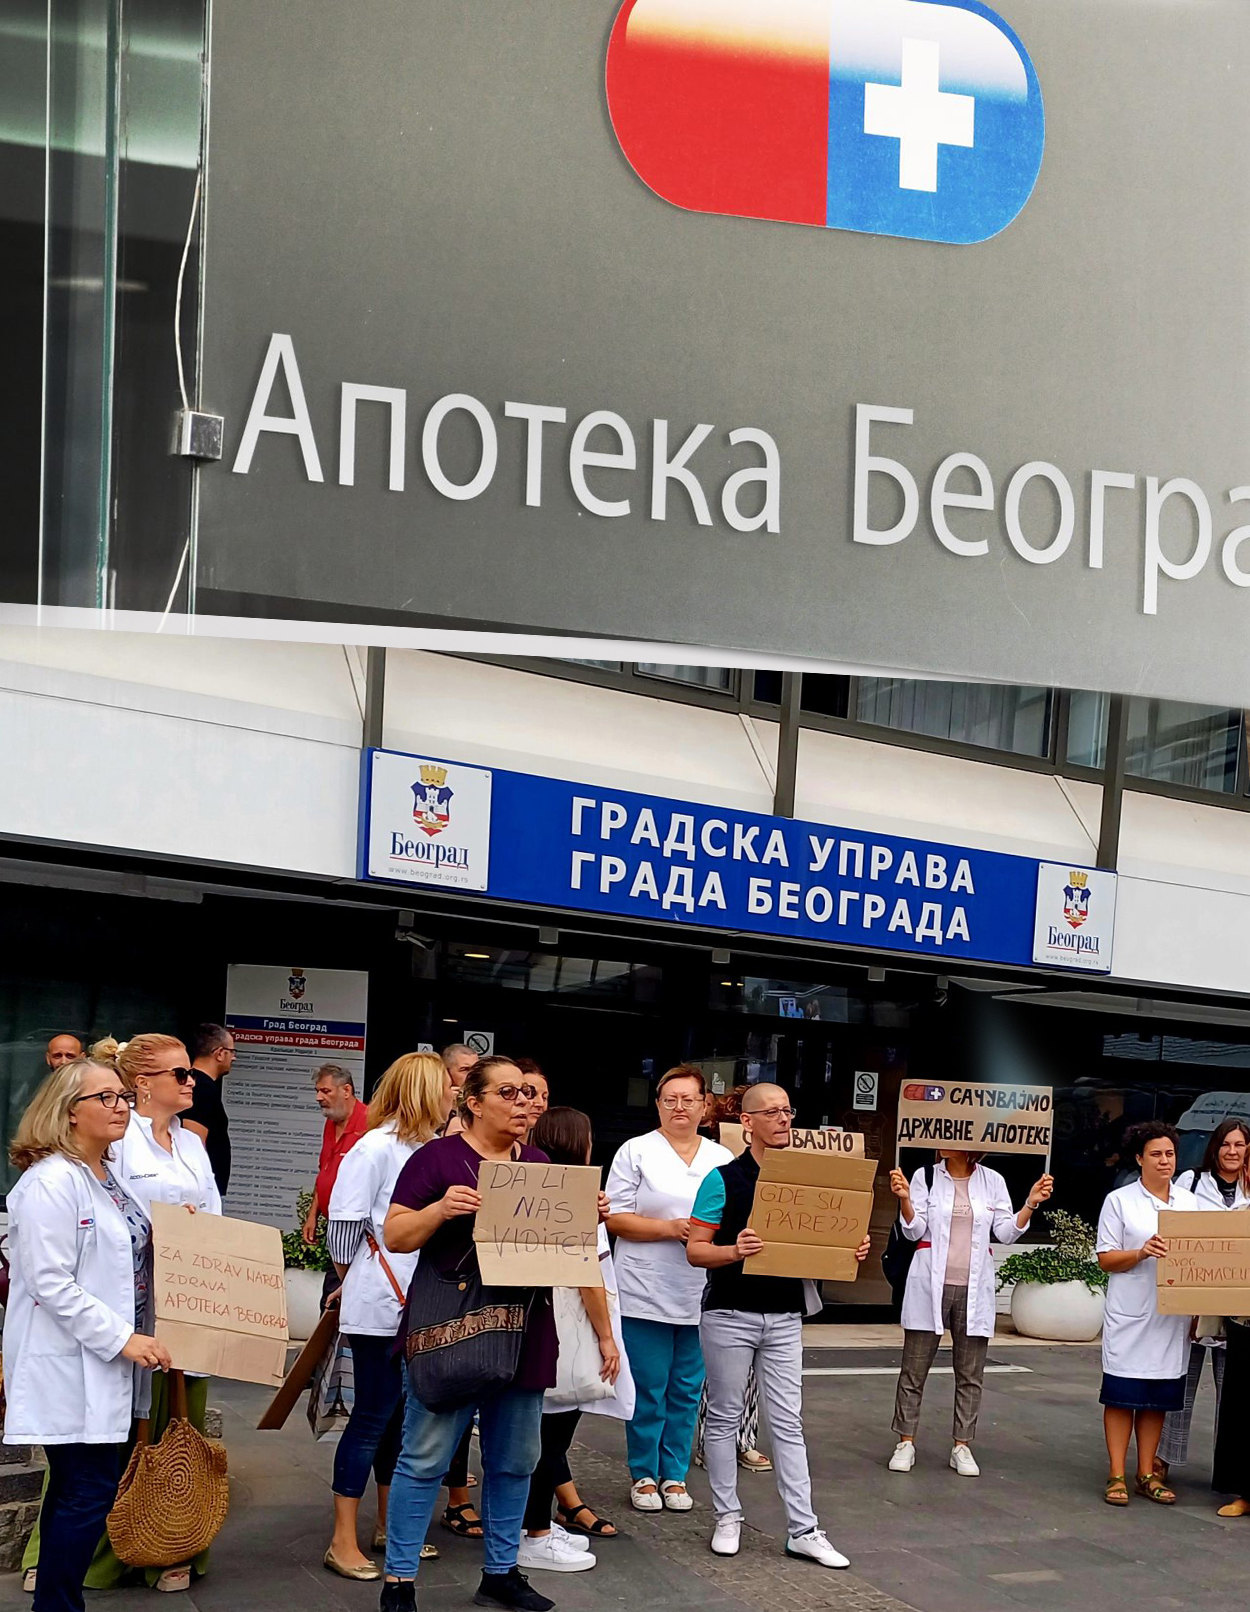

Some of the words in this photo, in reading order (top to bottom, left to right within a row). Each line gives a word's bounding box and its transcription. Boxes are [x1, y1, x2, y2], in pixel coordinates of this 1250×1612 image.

[231, 332, 781, 534] Апотека
[389, 830, 470, 871] Београд
[570, 795, 790, 862] ГРАДСКА
[807, 834, 976, 896] УПРАВА
[569, 850, 728, 913] ГРАДА
[746, 877, 971, 945] БЕОГРАДА
[1047, 925, 1100, 956] Београд
[279, 998, 314, 1014] Београд
[263, 1019, 286, 1030] Град
[288, 1020, 328, 1032] Београд
[265, 1033, 294, 1043] управа
[295, 1036, 319, 1046] града
[320, 1037, 359, 1048] Београда
[949, 1087, 1051, 1113] САЧУВАЈМО
[897, 1117, 974, 1143] ДРЖАВНЕ
[980, 1121, 1051, 1146] АПОТЕКЕ
[490, 1163, 527, 1190] DA
[759, 1184, 805, 1206] GDE
[513, 1195, 574, 1224] NAS
[765, 1208, 860, 1234] PARE???
[159, 1246, 183, 1262] ZA
[191, 1253, 242, 1278] ZDRAV
[1166, 1257, 1196, 1268] SVOG
[165, 1272, 227, 1293] ZDRAVA
[164, 1291, 231, 1317] APOTEKA
[233, 1305, 289, 1329] BEOGRAD
